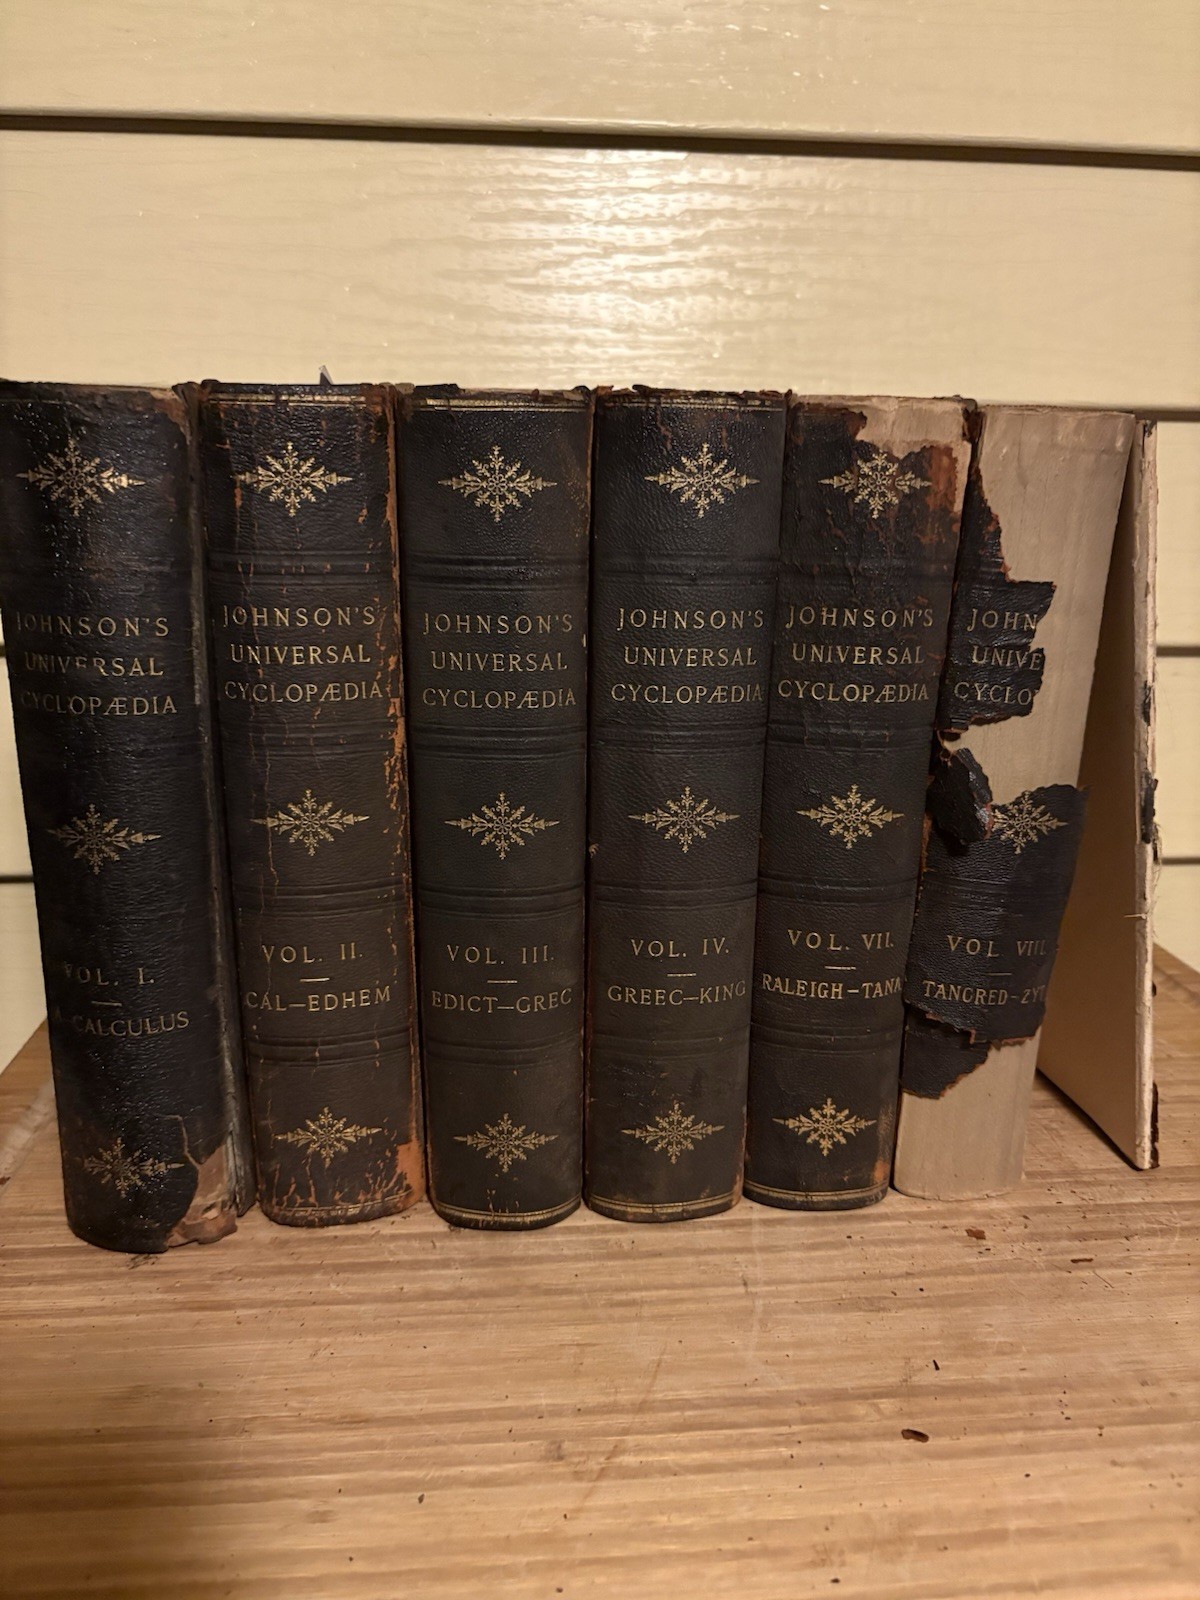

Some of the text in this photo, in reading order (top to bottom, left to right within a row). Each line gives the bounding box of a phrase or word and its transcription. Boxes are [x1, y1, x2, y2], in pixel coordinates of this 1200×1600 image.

[222, 605, 375, 627] JOHNSON'S
[423, 612, 573, 636] JOHNSON'S
[617, 607, 764, 631] JOHNSON'S
[785, 606, 934, 629] JOHNSON'S
[966, 608, 1038, 631] JOHN
[24, 651, 164, 677] UNIVERSAL
[230, 643, 371, 666] UNIVERSAL
[431, 651, 567, 673] UNIVERSAL
[624, 645, 757, 668] UNIVERSAL
[792, 642, 925, 665] UNIVERSAL
[972, 645, 1042, 671] UNIVE
[225, 680, 383, 704] CYCLOPÆDIA
[423, 688, 577, 710] CYCLOPÆDIA
[611, 683, 763, 705] CYCLOPÆDIA
[778, 679, 930, 703] CYCLOPÆDIA
[954, 681, 1039, 706] CYCLO
[631, 936, 729, 958] VOL. IV.
[788, 929, 894, 951] VOL. VII.
[262, 942, 363, 963] VOL. II.
[447, 944, 555, 964] VOL. III.
